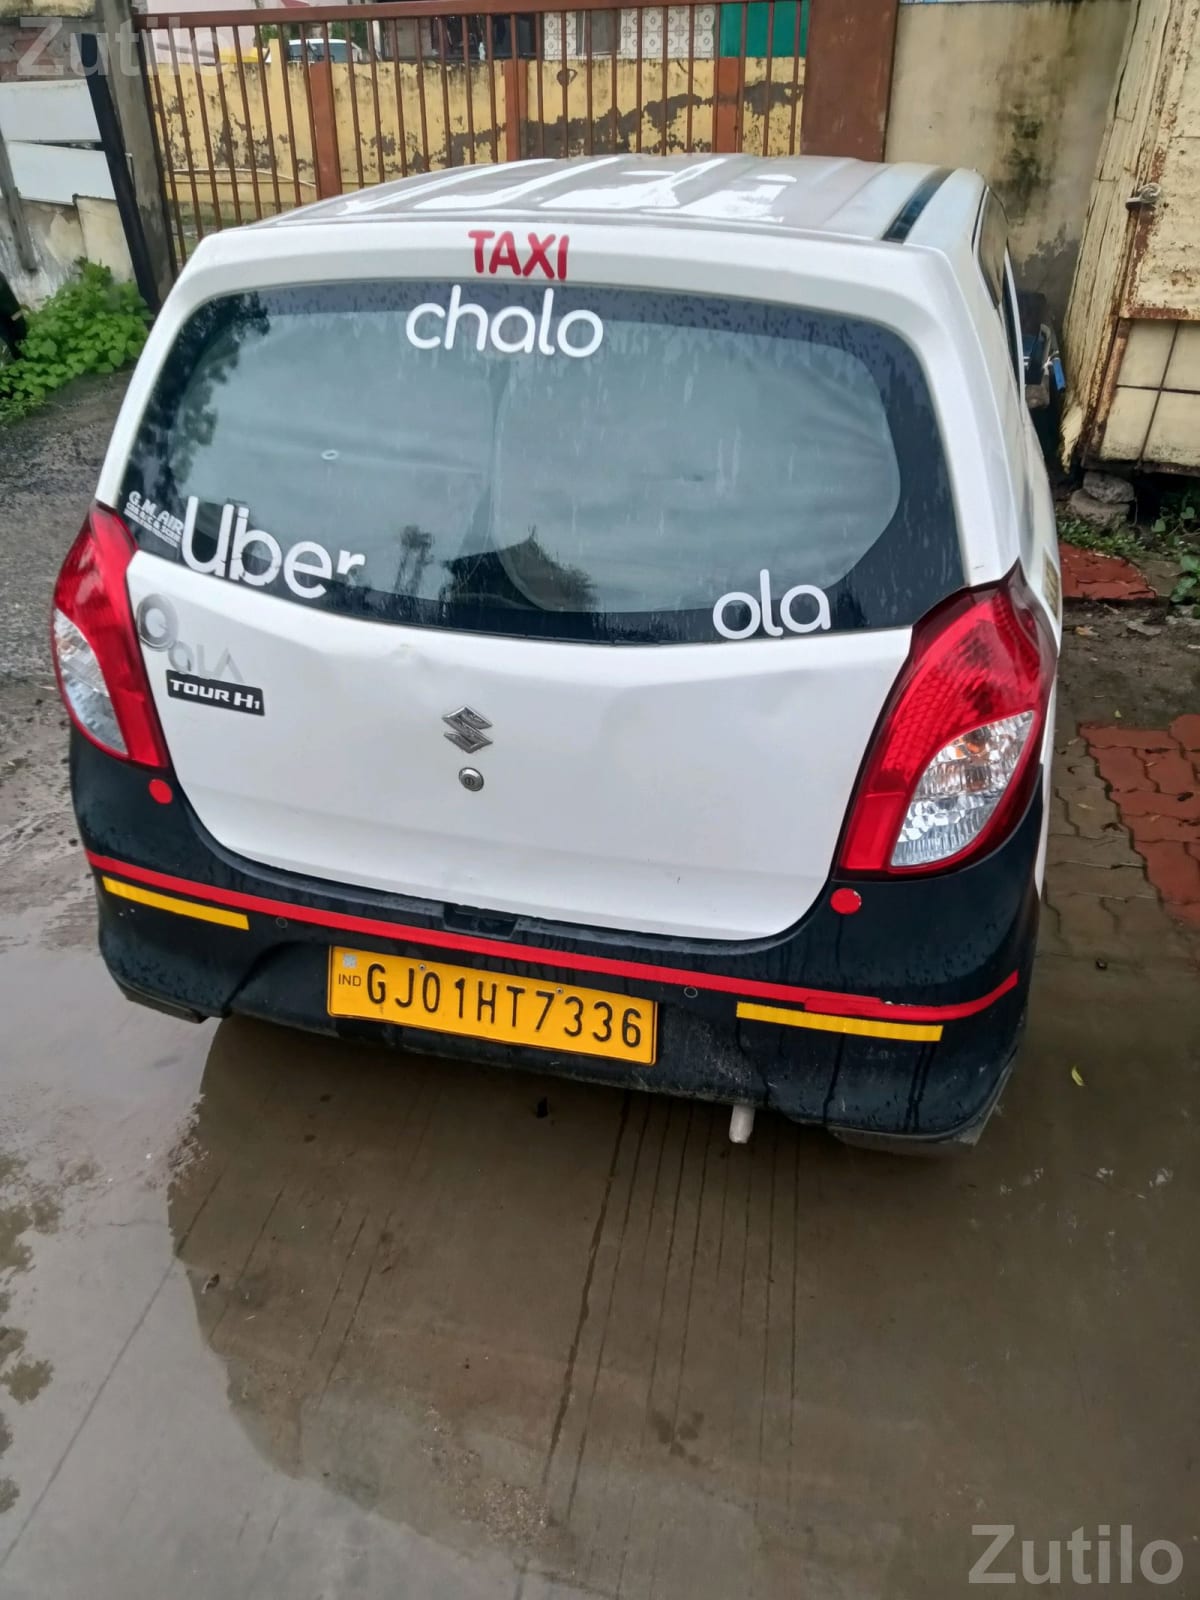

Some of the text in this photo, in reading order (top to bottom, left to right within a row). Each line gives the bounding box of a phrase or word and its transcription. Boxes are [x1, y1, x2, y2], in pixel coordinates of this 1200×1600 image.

[468, 230, 570, 280] TAXI
[406, 285, 604, 358] chalo
[182, 496, 366, 599] Uber
[713, 569, 831, 640] ola
[170, 679, 230, 703] TOUR
[338, 973, 362, 988] IND
[367, 963, 642, 1048] GJ01HT7336
